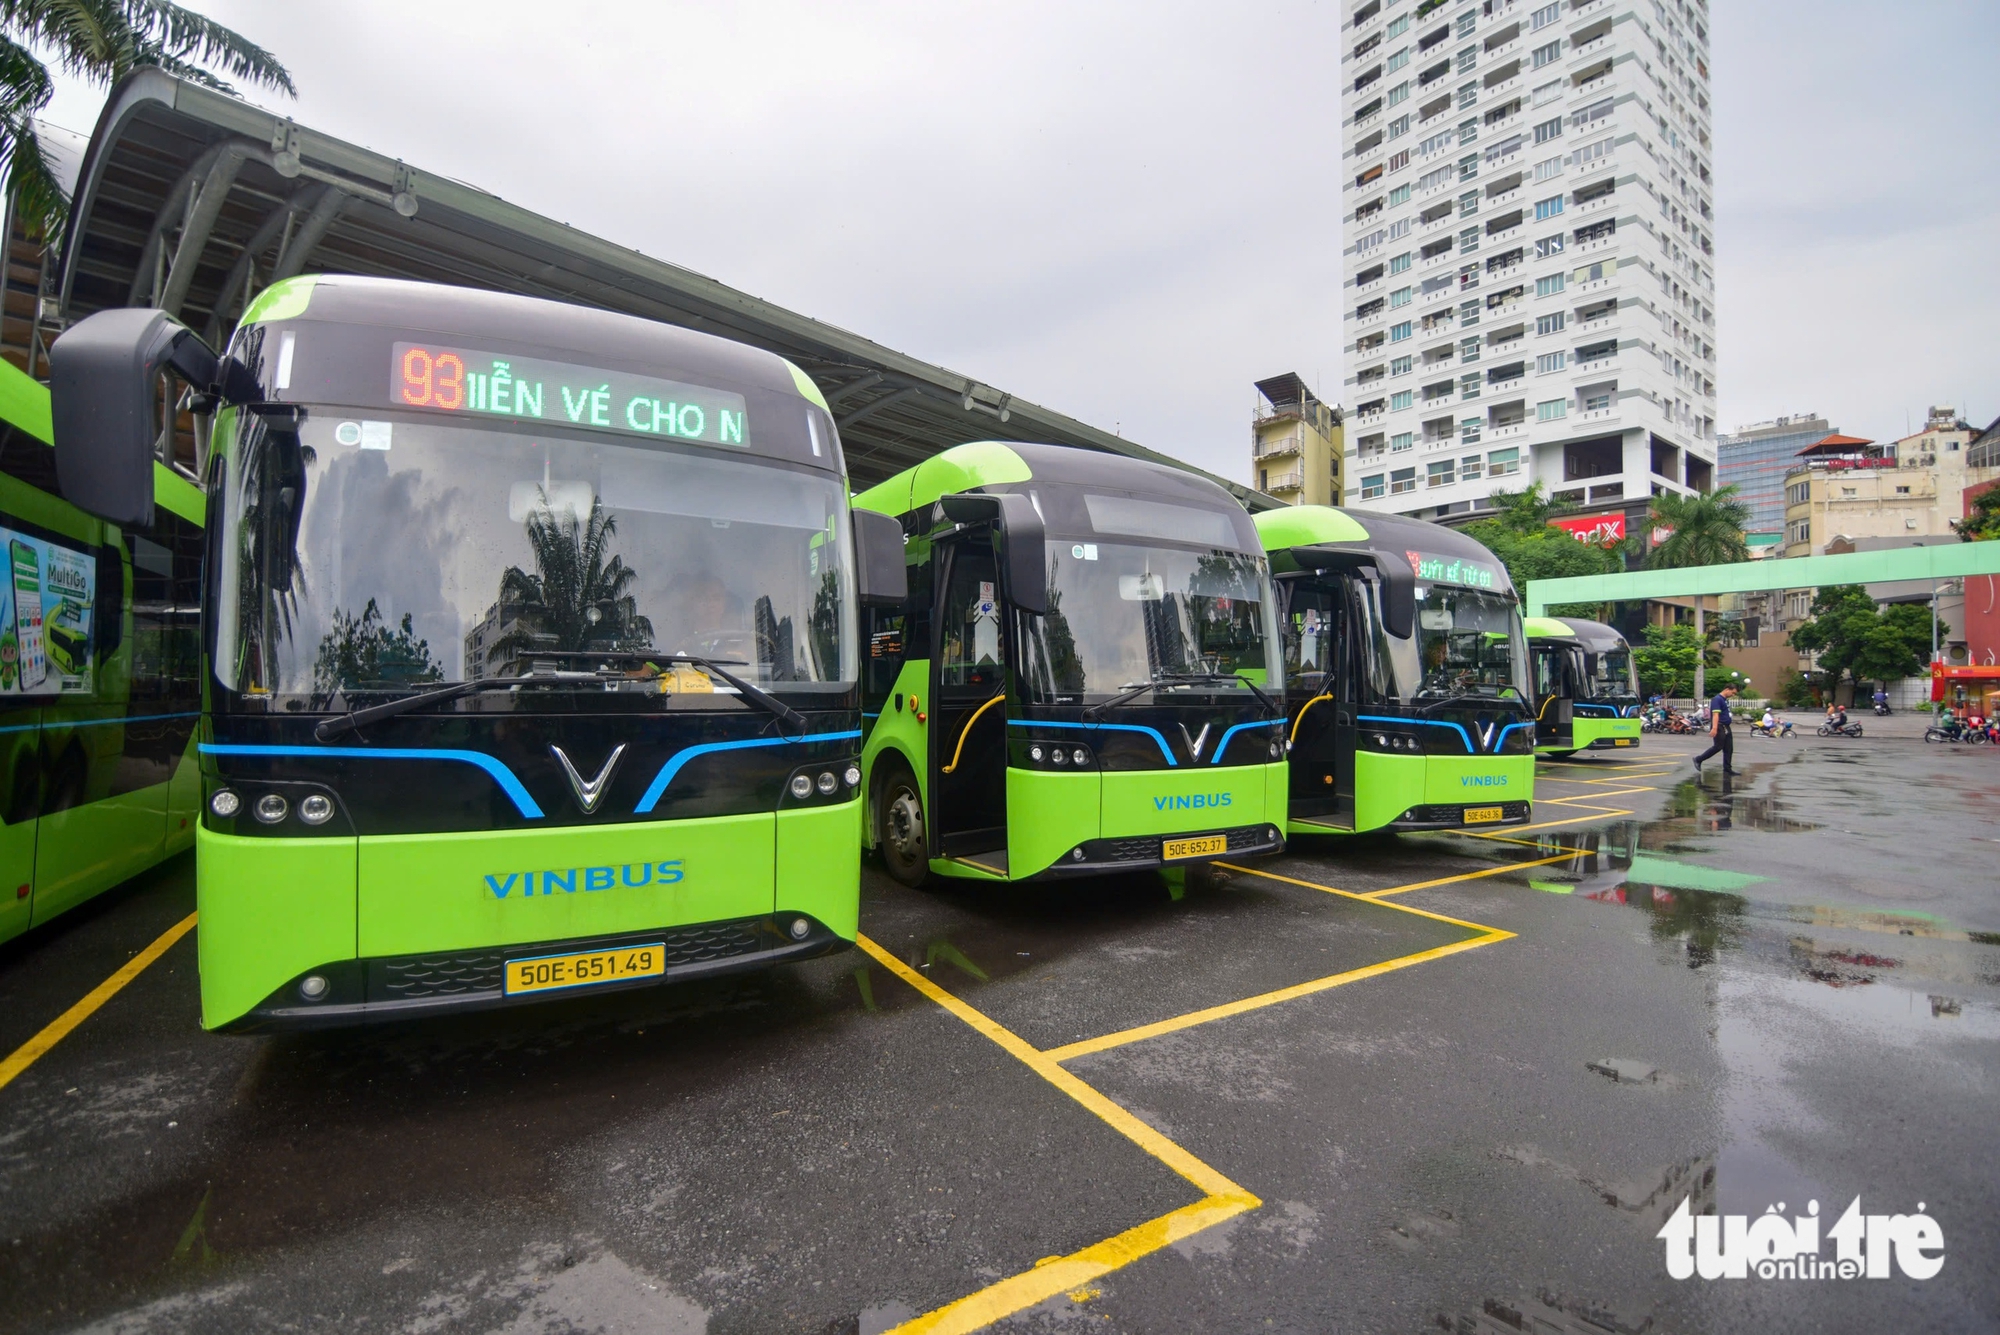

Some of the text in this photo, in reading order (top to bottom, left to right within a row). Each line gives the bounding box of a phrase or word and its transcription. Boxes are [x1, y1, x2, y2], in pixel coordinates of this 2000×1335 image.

[402, 347, 464, 410] 93
[561, 384, 611, 426] VÉ
[626, 396, 705, 439] CHO
[720, 409, 743, 443] N
[47, 563, 86, 589] MultiGo
[1461, 775, 1508, 786] VINBUS
[1153, 791, 1232, 811] VINBUS
[483, 859, 684, 898] VINBUS
[519, 952, 652, 987] 50E-651.49
